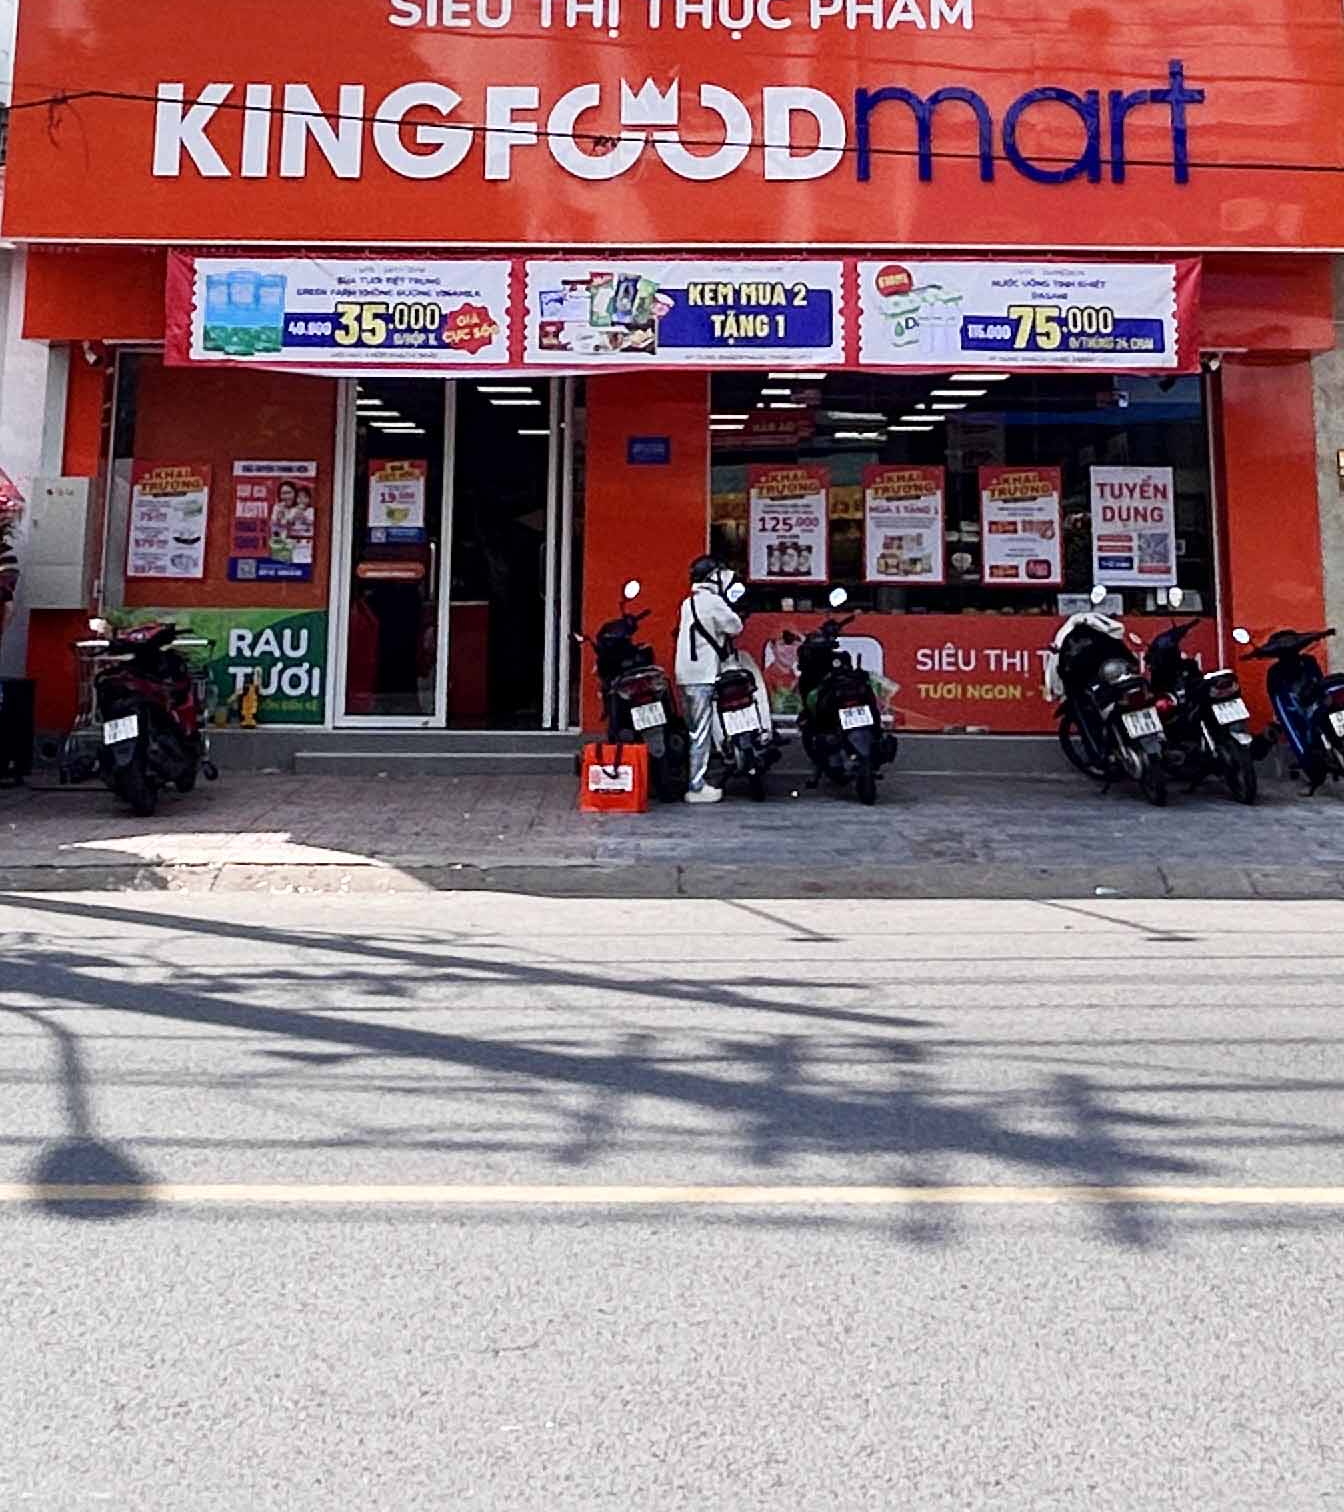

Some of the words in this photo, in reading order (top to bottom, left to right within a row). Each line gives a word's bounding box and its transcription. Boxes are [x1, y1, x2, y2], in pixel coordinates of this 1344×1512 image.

[687, 282, 735, 307] KEM
[738, 282, 788, 307] MUA
[790, 282, 809, 307] 2
[710, 308, 771, 345] TẶNG
[774, 313, 787, 338] 1
[1007, 304, 1114, 350] 75.000
[1095, 475, 1169, 502] TUYỂN
[1101, 505, 1166, 528] DỤNG
[227, 627, 309, 659] RAU
[915, 642, 977, 673] SIÊU
[982, 649, 1030, 679] THỊ
[227, 661, 322, 697] TƯƠI
[918, 682, 963, 700] TƯƠI
[966, 684, 1023, 701] NGON
